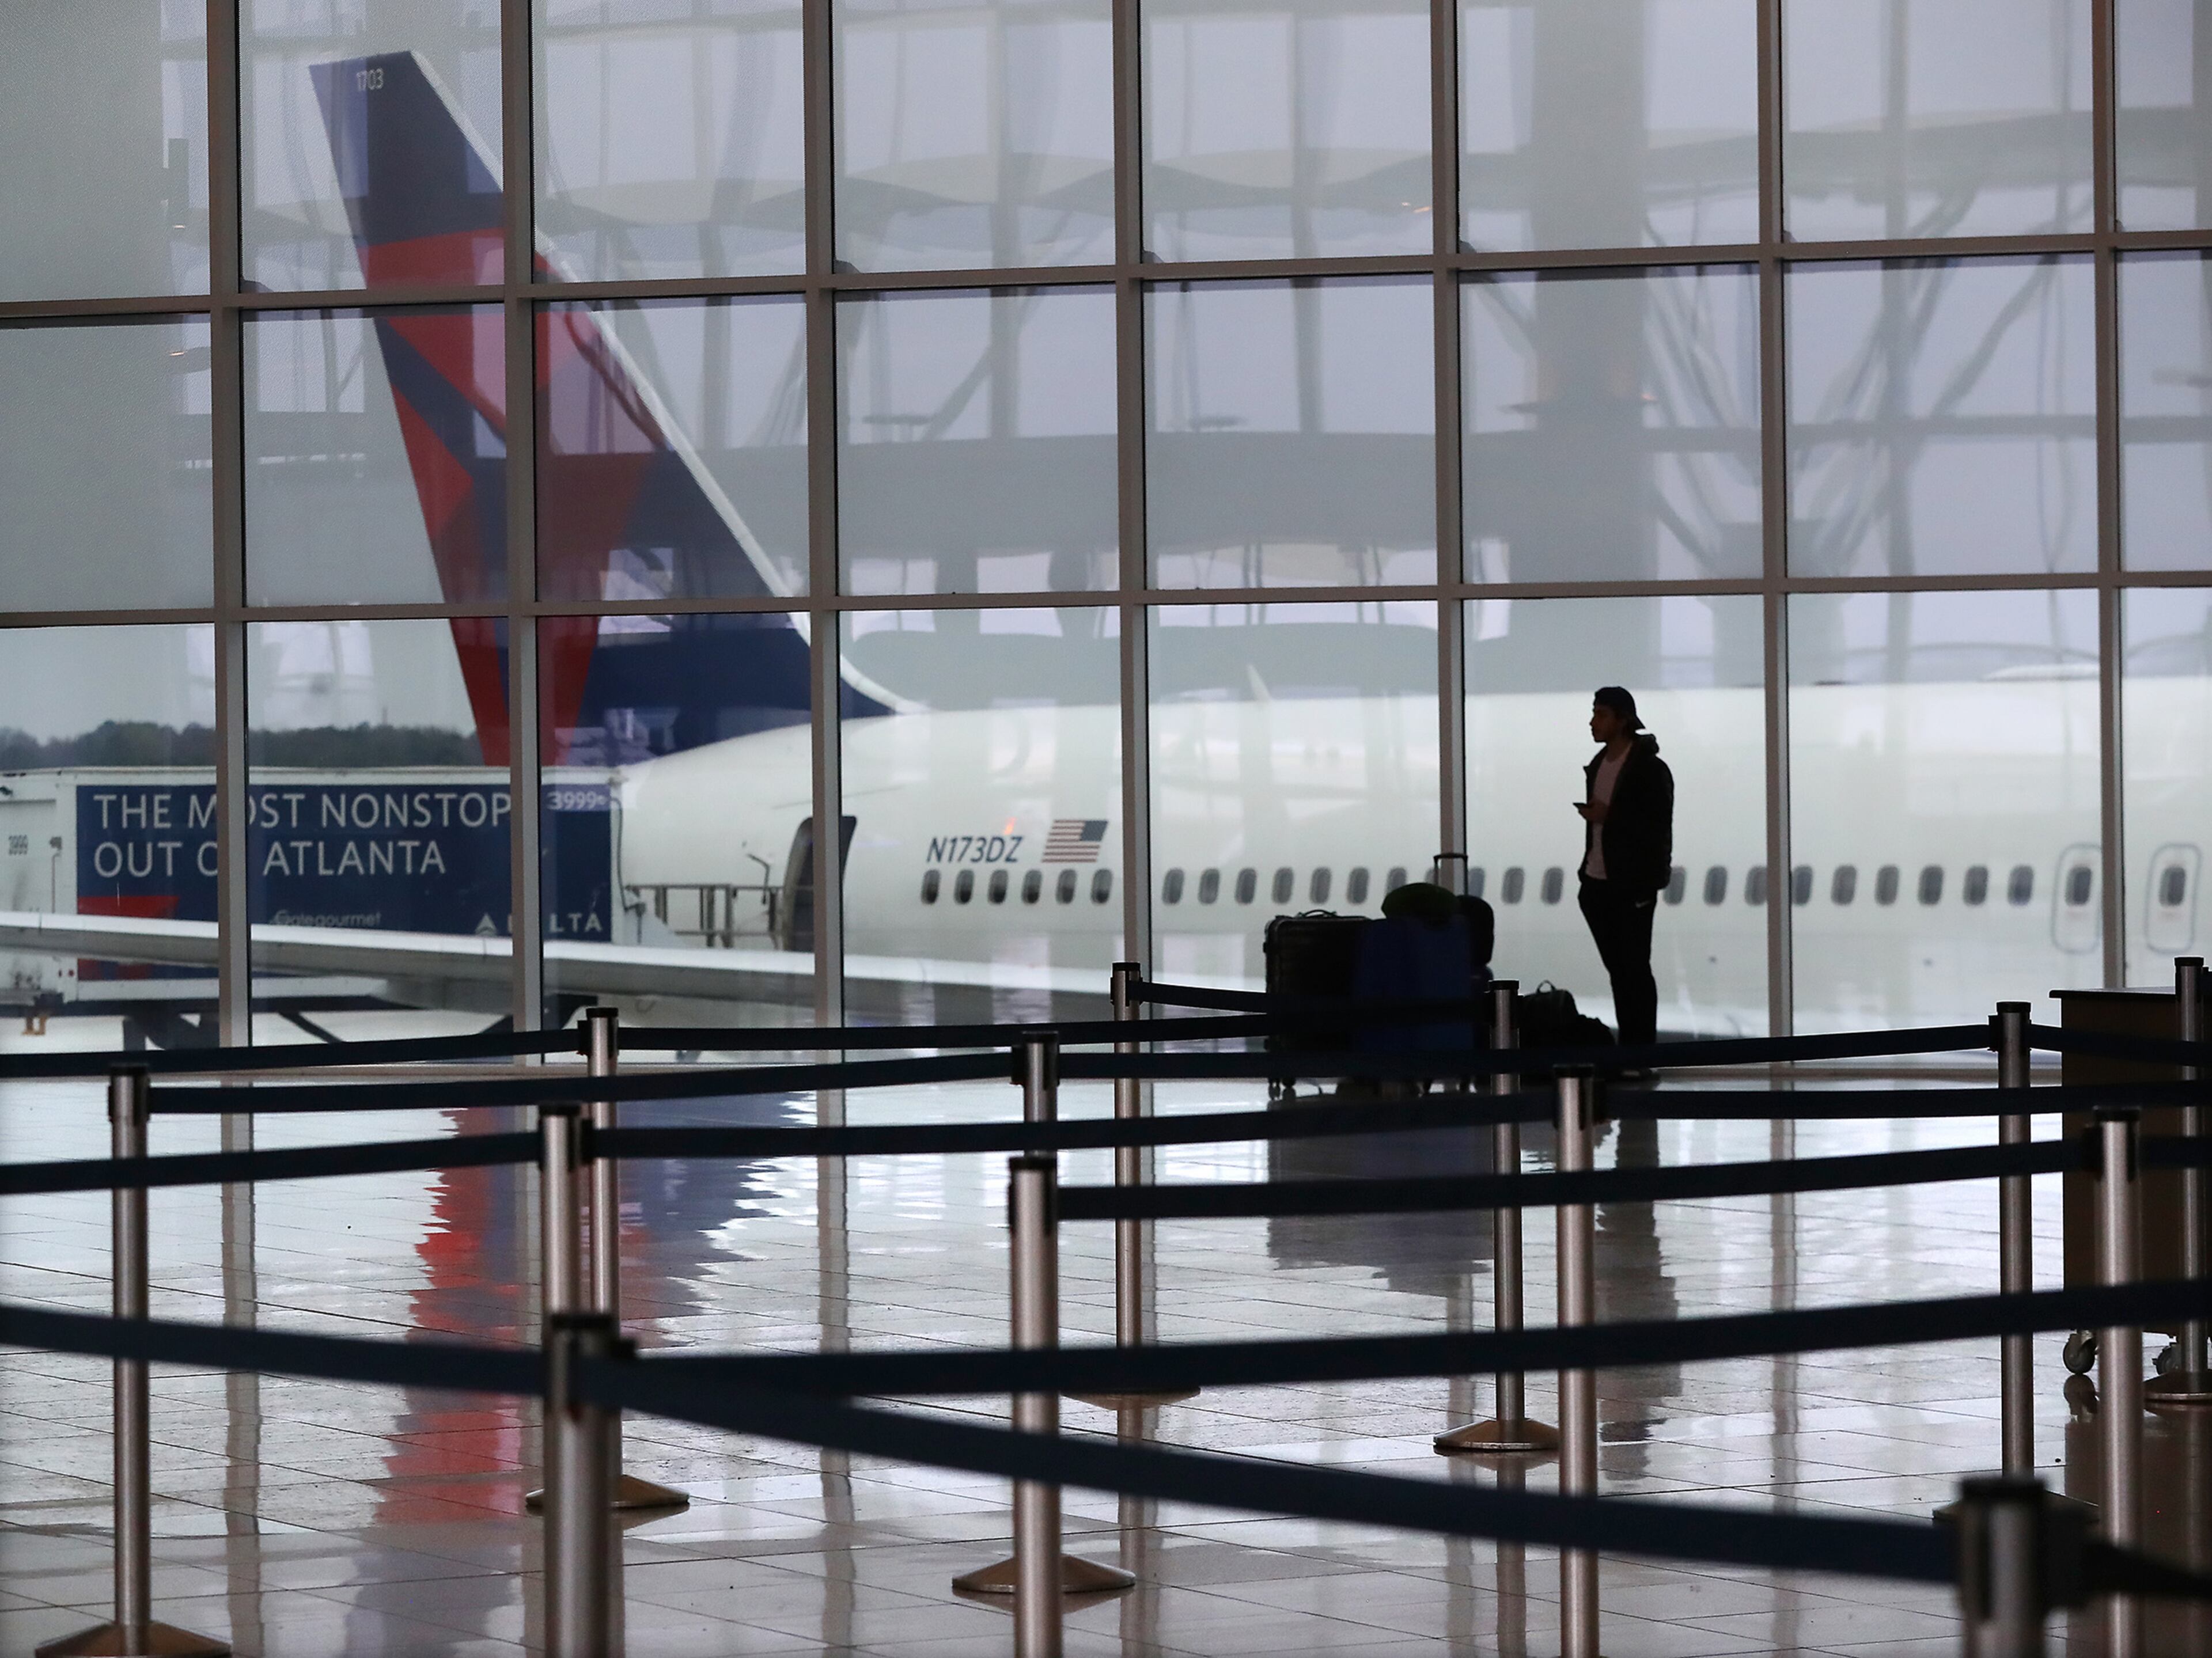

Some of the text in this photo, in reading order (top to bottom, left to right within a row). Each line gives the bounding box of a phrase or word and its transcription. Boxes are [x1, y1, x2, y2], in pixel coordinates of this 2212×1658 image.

[355, 68, 384, 92] 1703
[93, 792, 512, 829] THE MST NONSTOP
[94, 841, 183, 878] OUT
[263, 840, 446, 877] ATLANTA
[926, 836, 1024, 863] N173DZ
[507, 912, 603, 934] LTA
